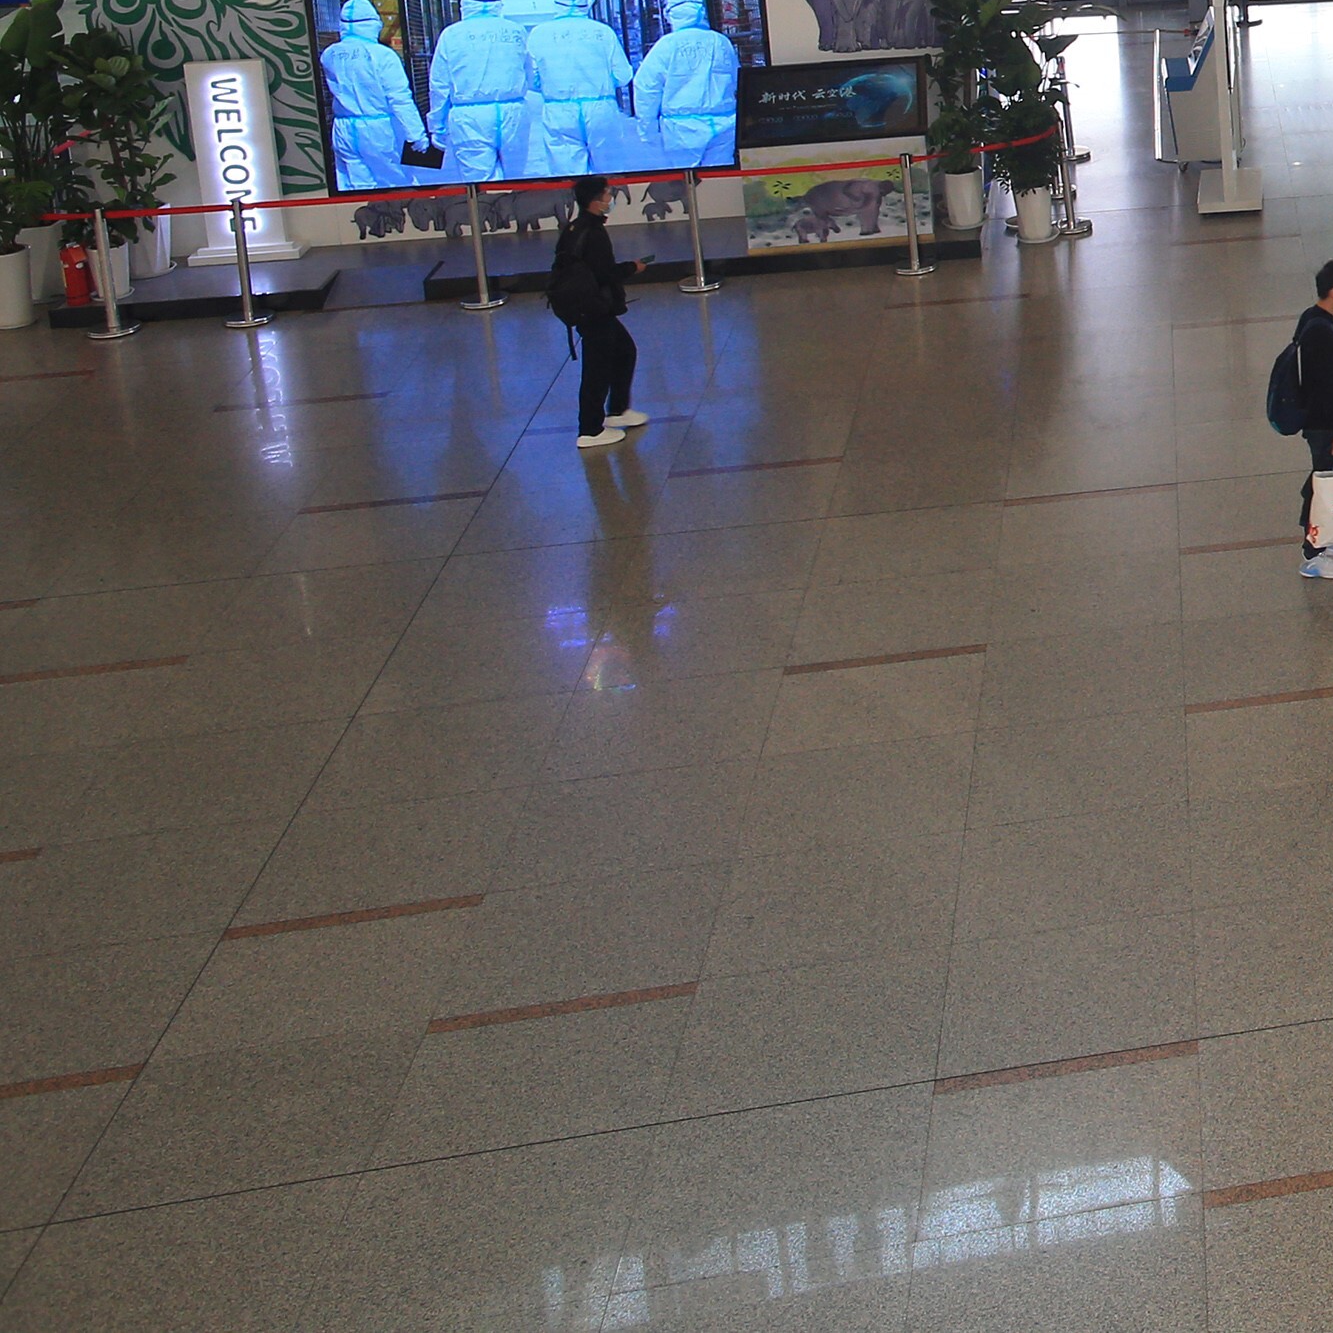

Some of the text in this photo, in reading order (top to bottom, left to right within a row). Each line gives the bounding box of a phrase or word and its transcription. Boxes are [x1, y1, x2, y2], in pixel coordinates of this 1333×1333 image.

[758, 86, 856, 104] 新时代 云空港
